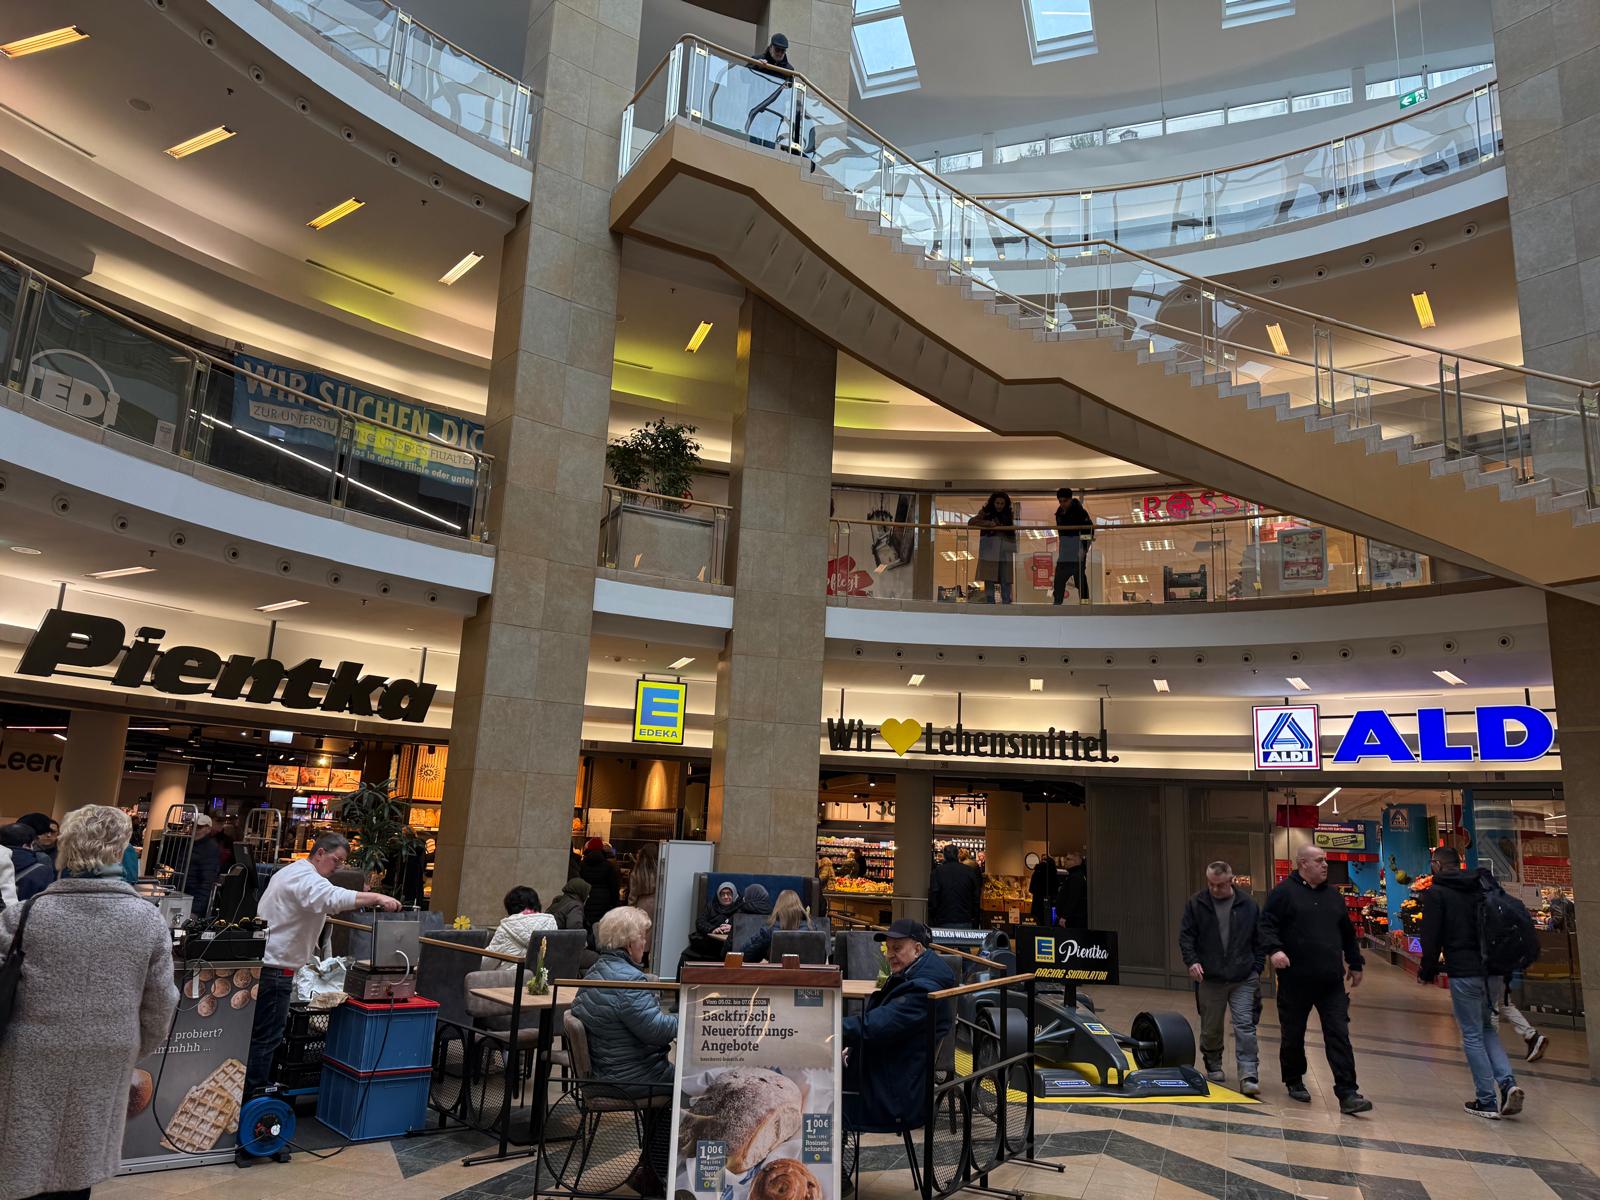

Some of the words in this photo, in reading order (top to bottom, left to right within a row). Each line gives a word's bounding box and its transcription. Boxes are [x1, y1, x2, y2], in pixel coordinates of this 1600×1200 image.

[243, 360, 307, 406] WIR
[318, 381, 430, 438] SUCHEN
[253, 405, 280, 418] ZUR
[377, 455, 402, 468] dieser
[404, 461, 430, 475] Filiale
[431, 469, 450, 481] oder
[14, 608, 438, 724] Pientka
[639, 728, 678, 739] EDEKA
[827, 718, 874, 752] Wir
[1266, 750, 1310, 762] ALDI
[1058, 939, 1110, 964] Pientka
[1034, 967, 1065, 979] RACING
[1065, 968, 1108, 981] SIMULATOR
[702, 1010, 776, 1022] Backfrische
[174, 1028, 223, 1042] probiert?
[701, 1025, 799, 1039] Neueröffnungs-
[701, 1040, 759, 1054] Angebote
